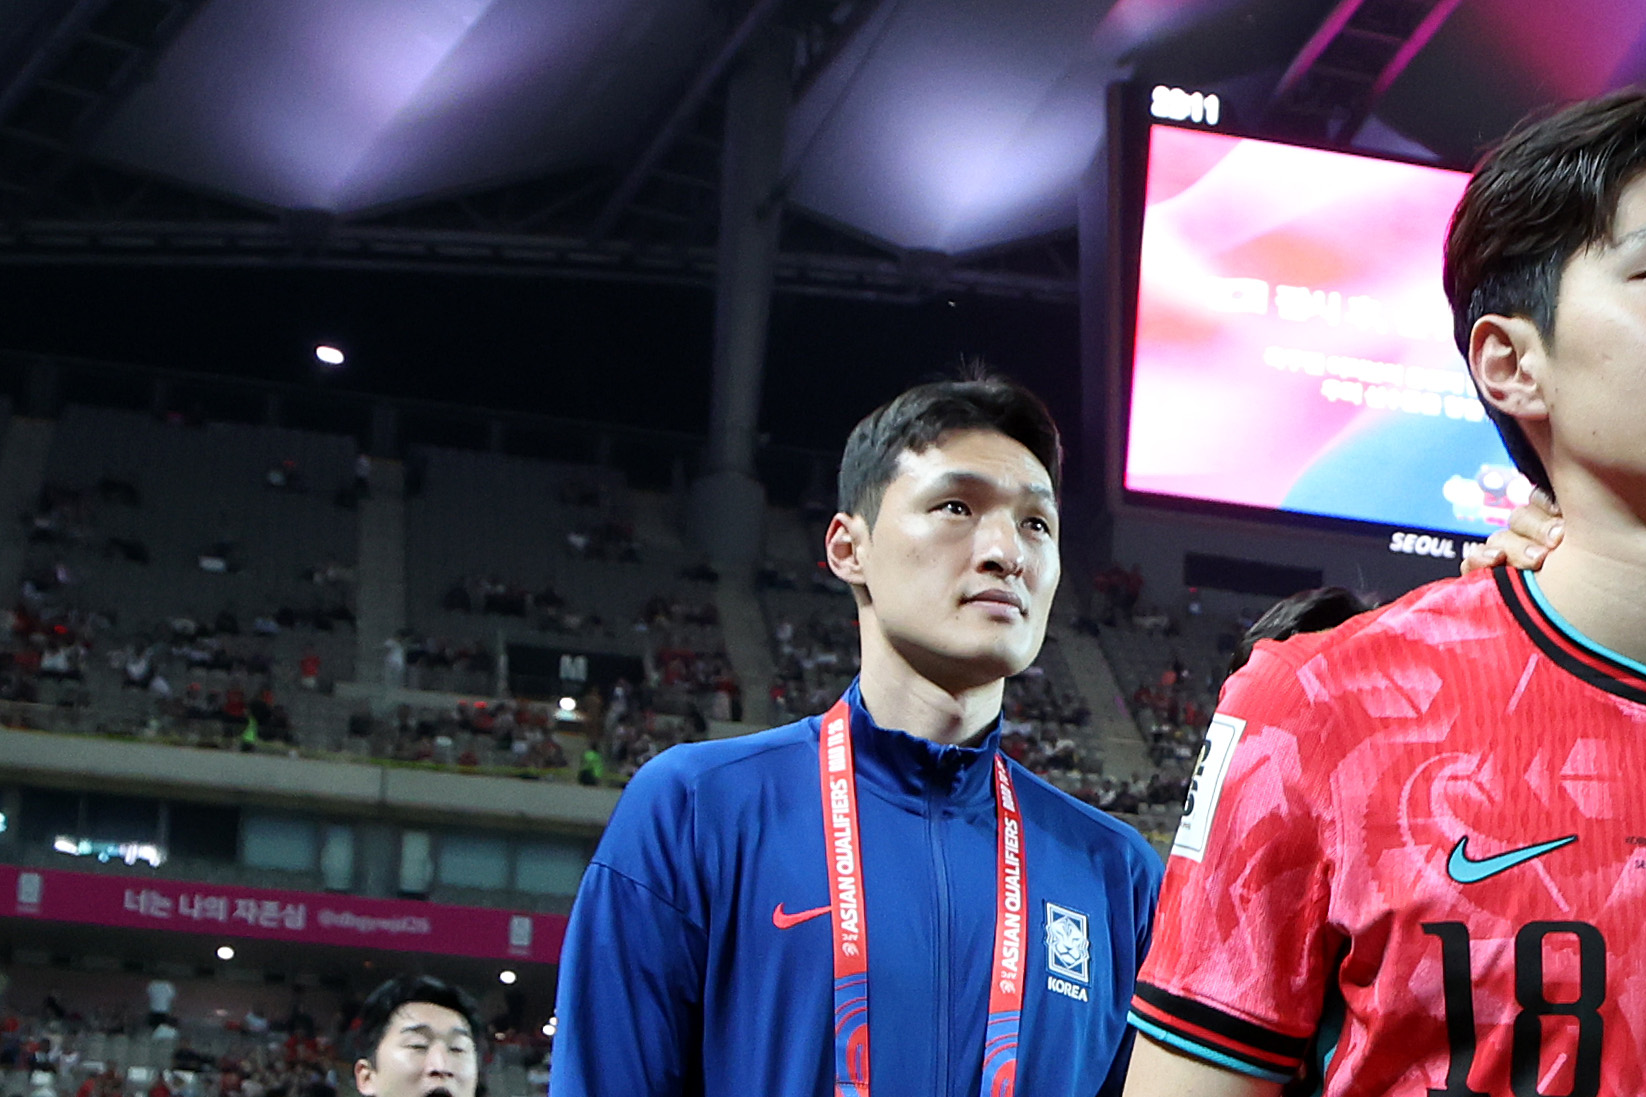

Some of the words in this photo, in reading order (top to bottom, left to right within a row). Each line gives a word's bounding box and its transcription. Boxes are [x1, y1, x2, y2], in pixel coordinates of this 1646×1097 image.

[1389, 531, 1457, 559] SEOUL
[829, 777, 855, 876] QUALIFIERS
[1003, 814, 1021, 912] QUALIFIERS
[124, 889, 173, 919] 너는
[178, 893, 228, 923] 나의
[232, 898, 308, 931] 자존심
[837, 875, 859, 934] ASIAN
[1001, 912, 1021, 972] ASIAN
[1047, 975, 1089, 1002] KOREA
